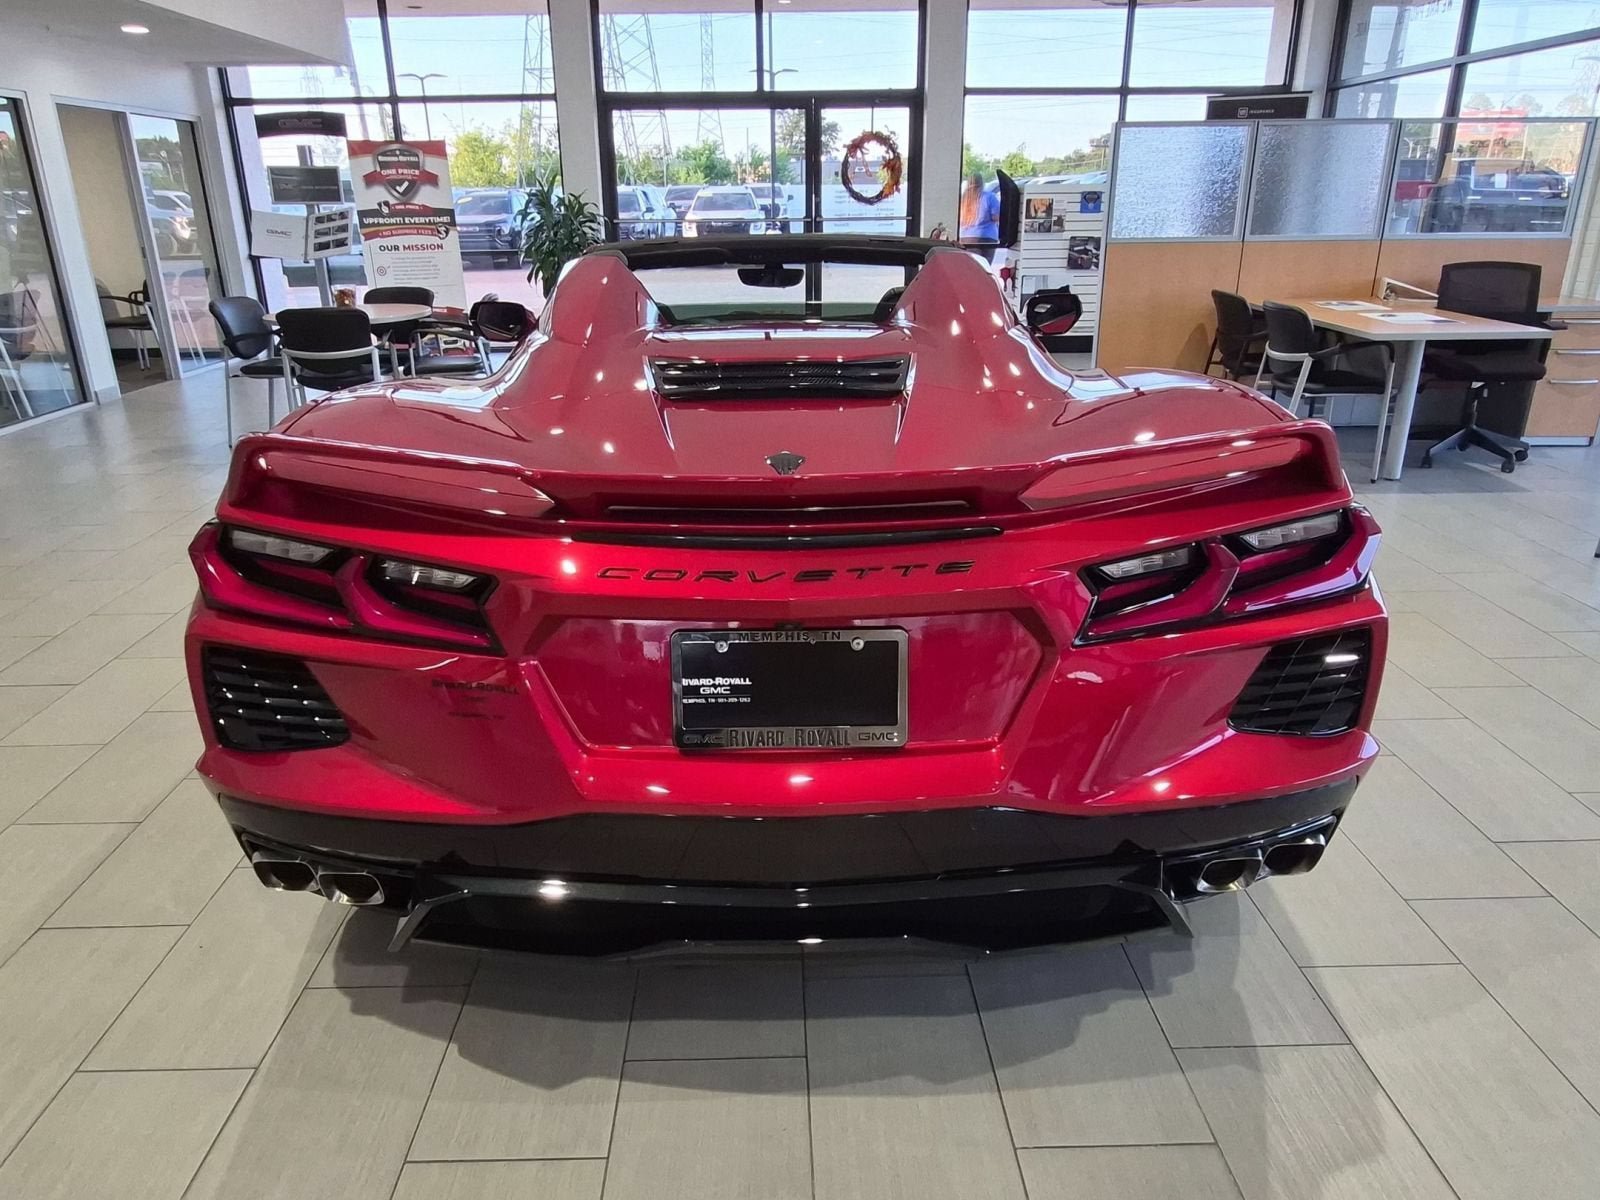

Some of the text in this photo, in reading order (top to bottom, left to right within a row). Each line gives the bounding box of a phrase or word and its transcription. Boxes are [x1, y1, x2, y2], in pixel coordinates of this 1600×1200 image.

[398, 168, 420, 176] PRICE
[266, 228, 293, 237] GMC
[379, 243, 444, 252] OUR MISSION
[597, 559, 976, 584] CORVETTE
[738, 630, 841, 642] MEMPHIS, TN
[729, 729, 785, 747] RIVARD
[794, 728, 851, 747] ROYALL
[858, 732, 898, 742] GMC
